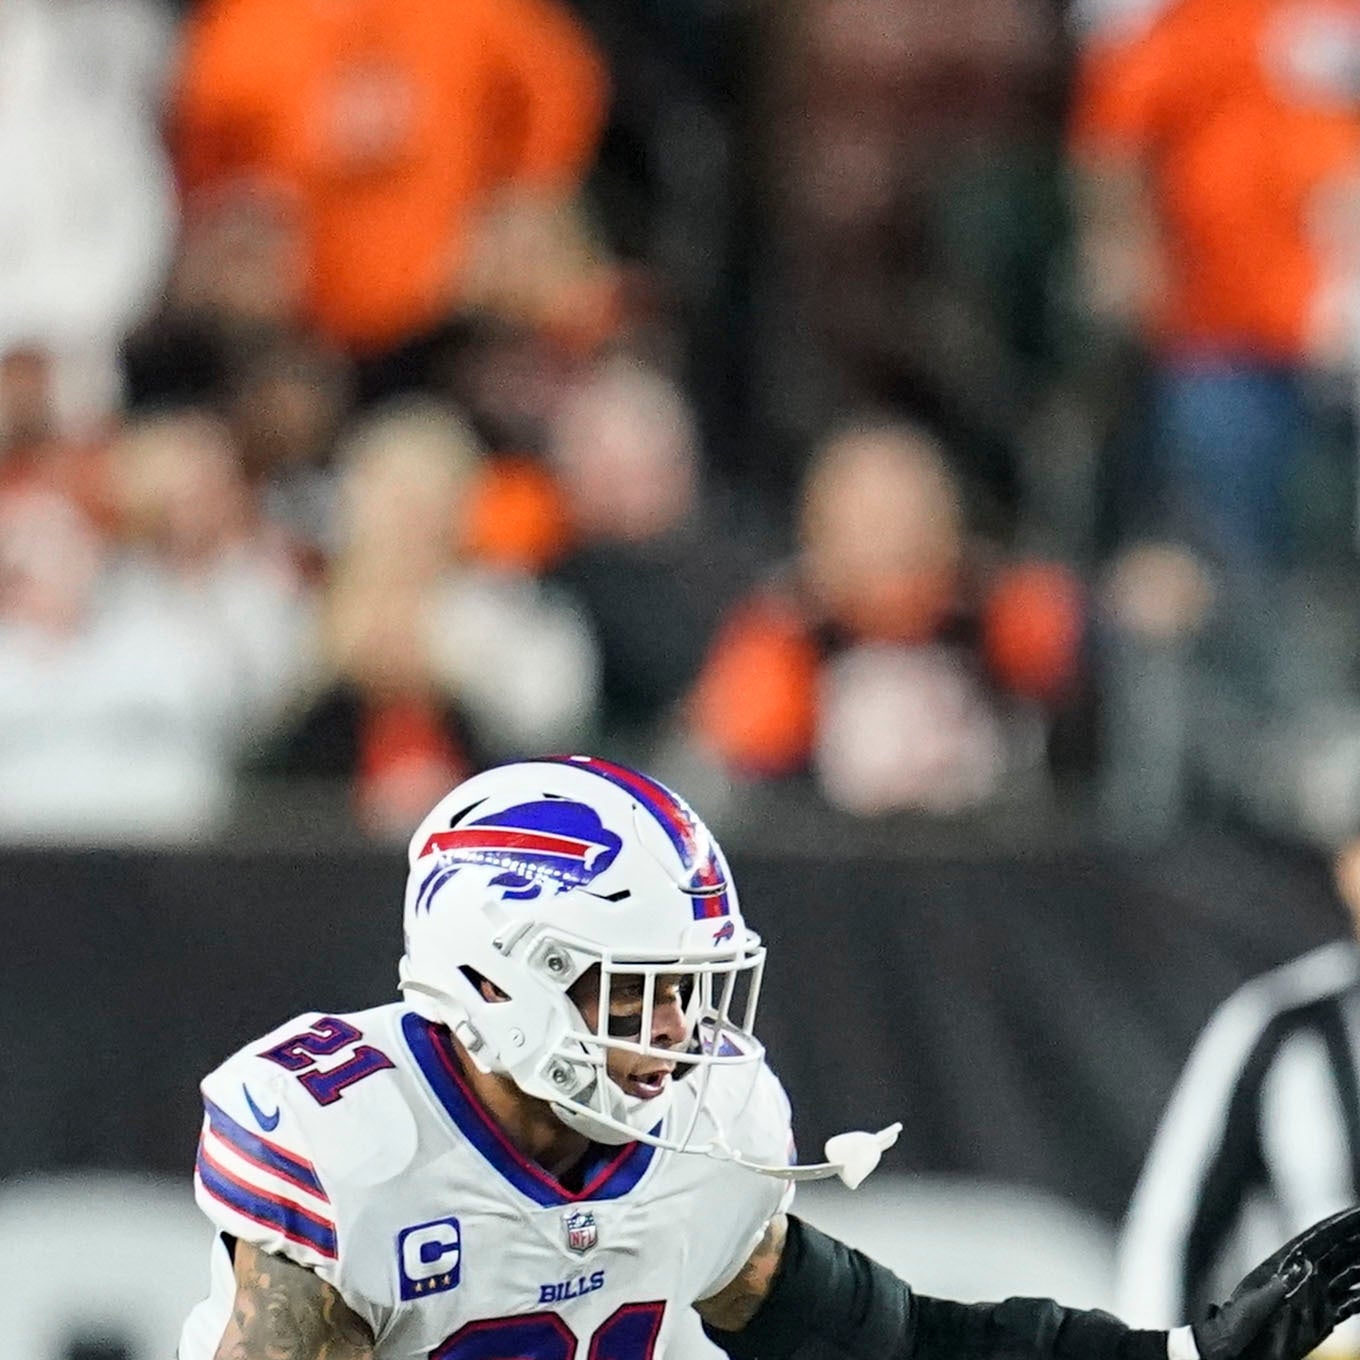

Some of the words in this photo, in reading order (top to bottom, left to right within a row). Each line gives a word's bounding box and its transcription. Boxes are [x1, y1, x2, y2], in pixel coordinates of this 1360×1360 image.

[257, 1015, 397, 1107] 21
[402, 1222, 459, 1281] C
[538, 1270, 605, 1304] BILLS
